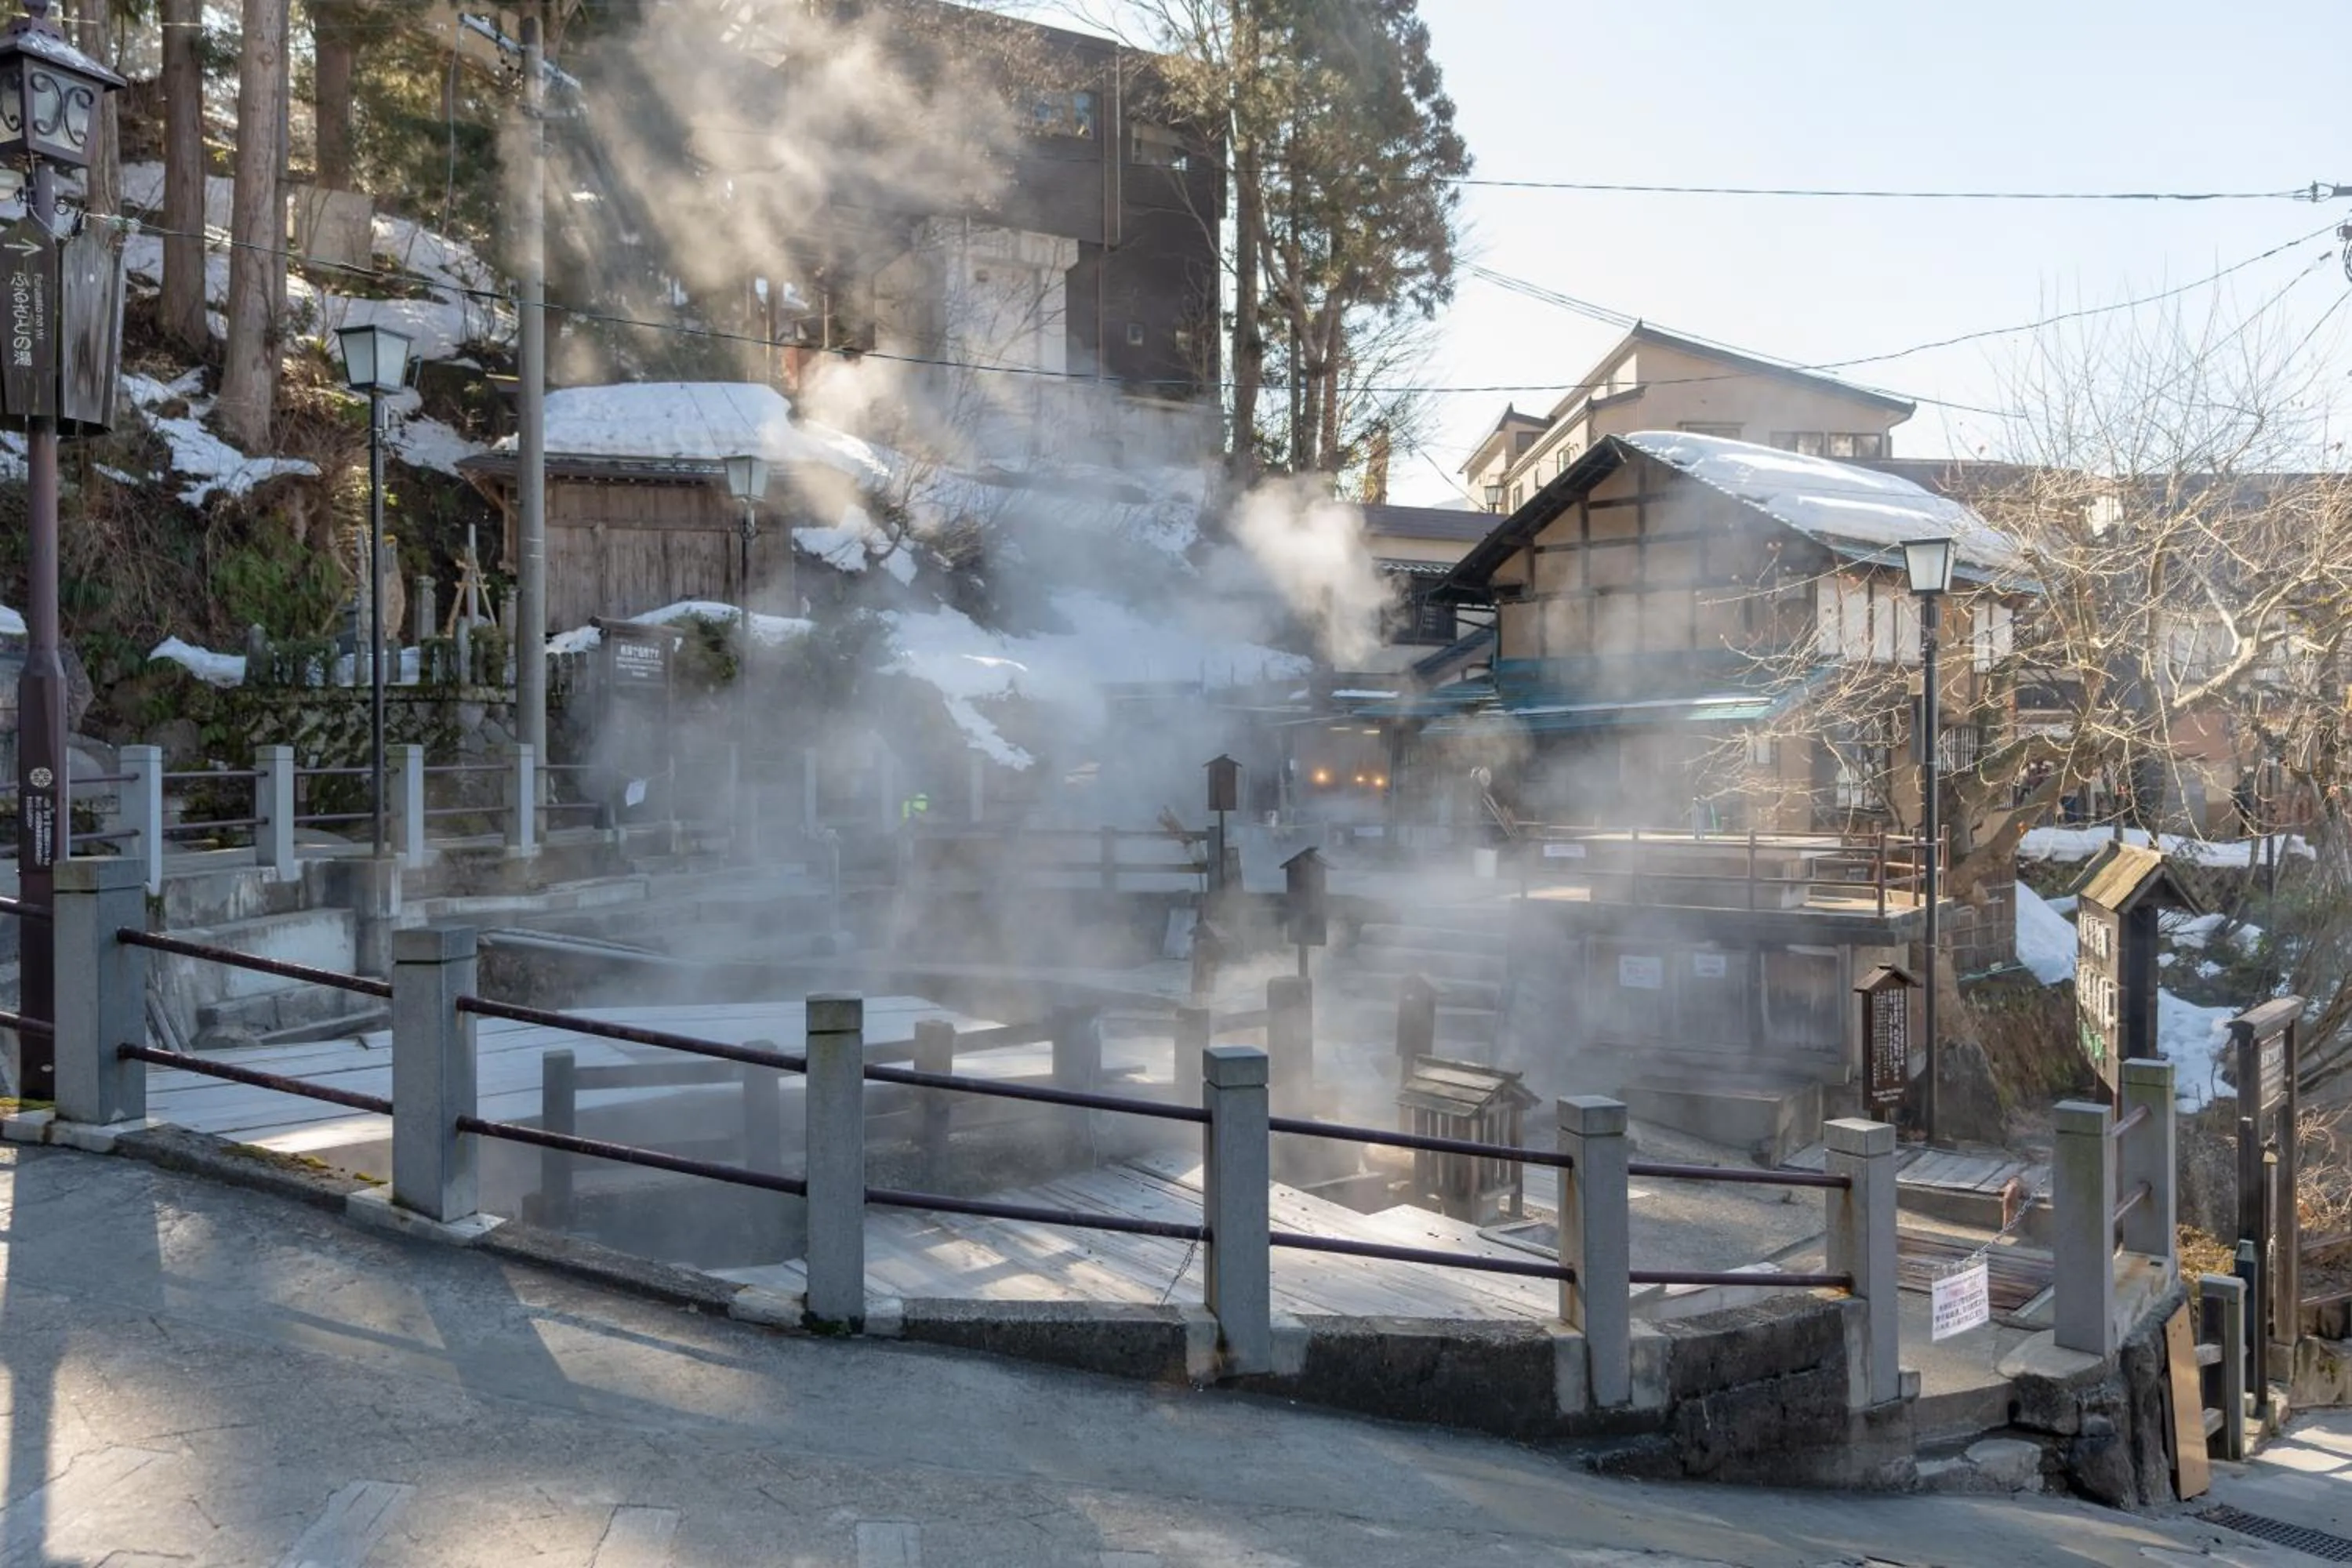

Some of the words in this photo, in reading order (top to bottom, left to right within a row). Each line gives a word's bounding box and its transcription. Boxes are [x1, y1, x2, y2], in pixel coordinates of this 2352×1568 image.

[10, 272, 32, 366] ふるさとの湯
